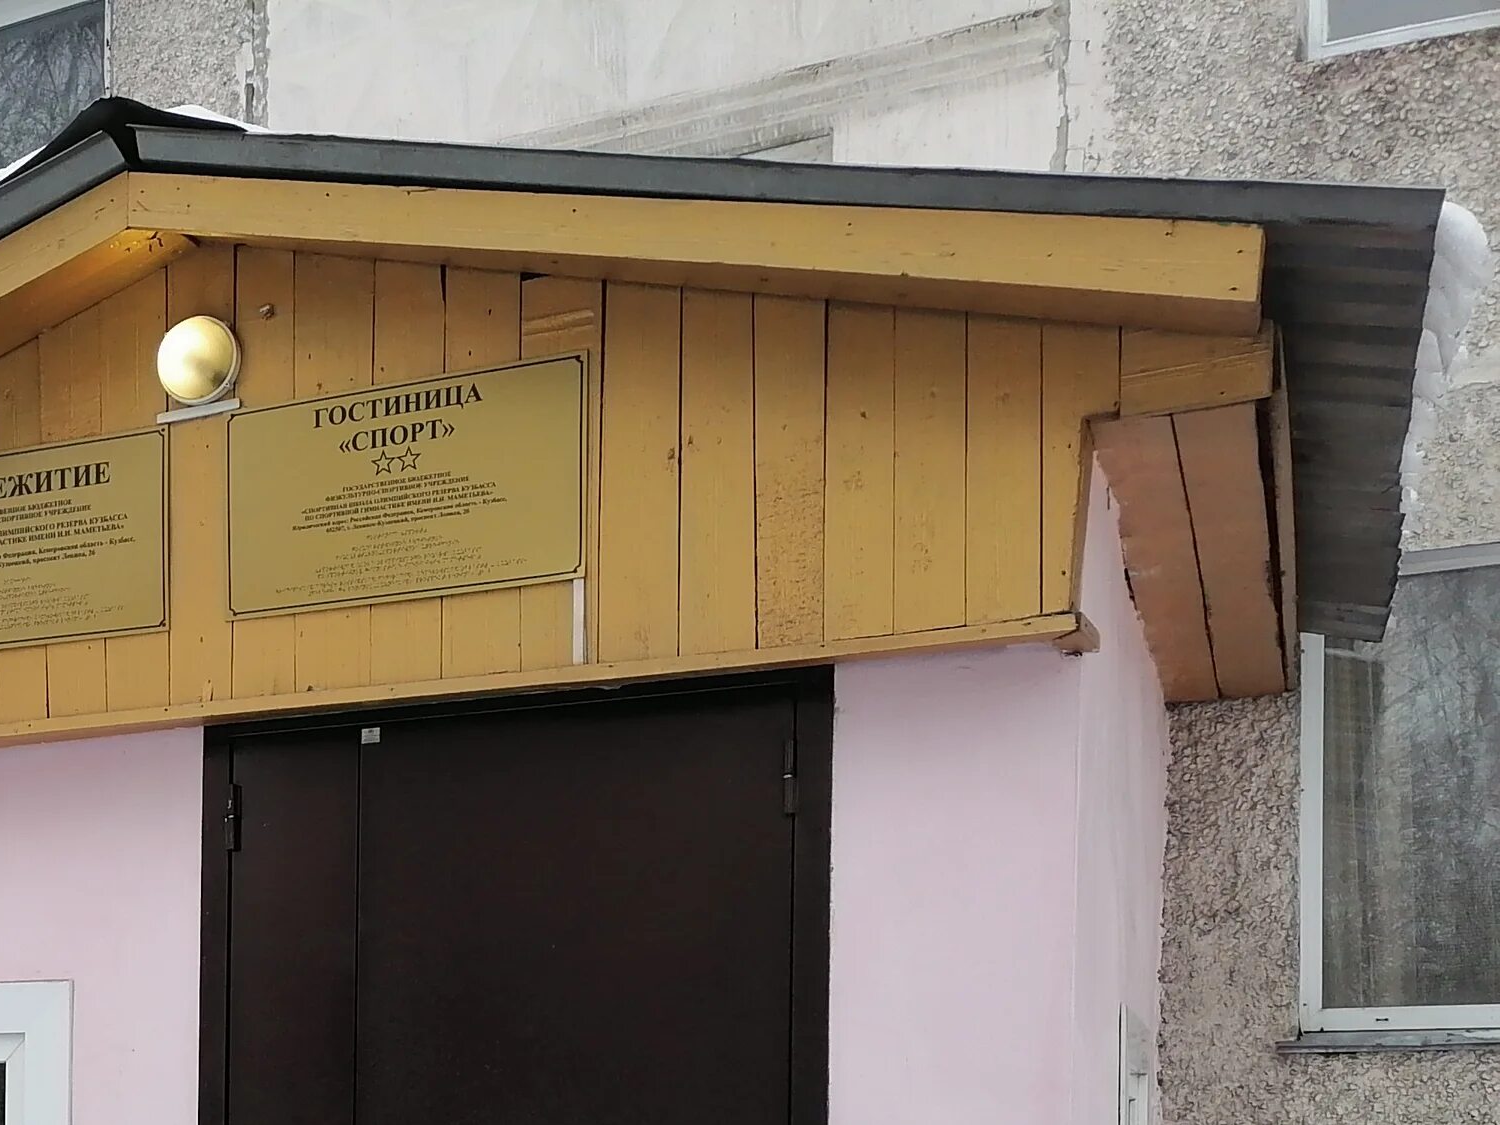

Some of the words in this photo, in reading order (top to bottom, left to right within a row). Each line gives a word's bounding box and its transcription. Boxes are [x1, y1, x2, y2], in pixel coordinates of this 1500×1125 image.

[313, 383, 483, 429] ГОСТИНИЦА
[339, 418, 455, 454] «СПОРТ»
[56, 518, 87, 528] РЕЗЕРВА
[89, 512, 127, 524] КУЗБАССА
[28, 531, 55, 541] ИМЕНИ
